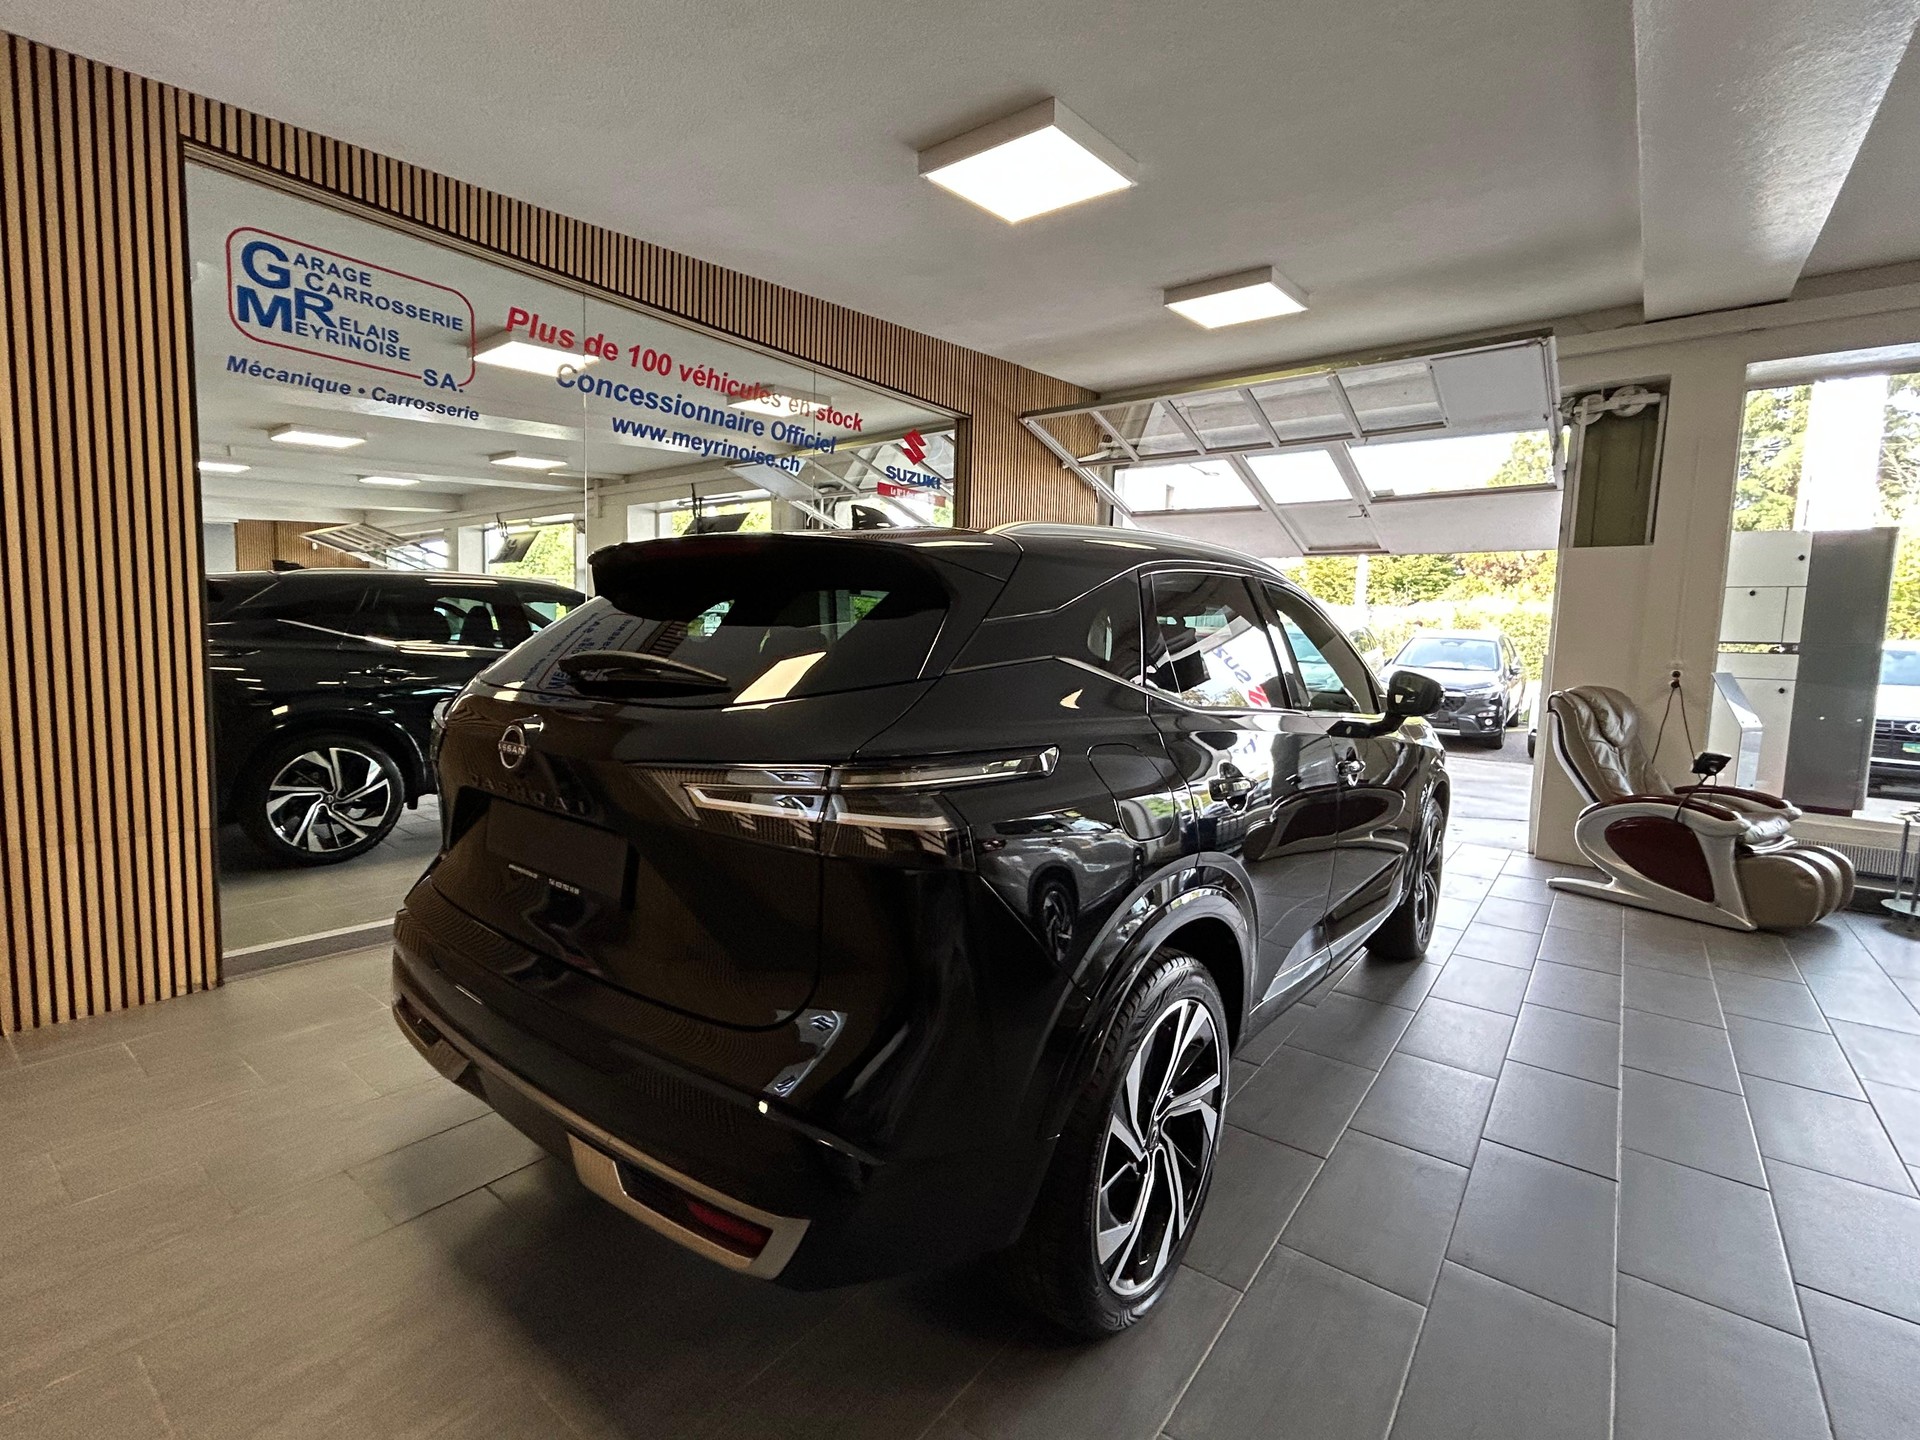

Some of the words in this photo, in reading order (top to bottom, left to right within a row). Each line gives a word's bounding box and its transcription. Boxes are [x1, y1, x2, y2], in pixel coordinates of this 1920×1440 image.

[241, 240, 372, 289] GARAGE
[236, 285, 411, 362] MEYRINOISE
[295, 288, 399, 343] RELAIS
[304, 272, 464, 332] CARROSSERIE
[226, 355, 352, 396] Mécanique
[371, 386, 480, 421] Carrosserie
[423, 368, 464, 393] SA.
[505, 306, 575, 349] Plus
[584, 333, 619, 361] de
[628, 345, 673, 377] 100
[679, 364, 781, 408] véhicules
[788, 398, 811, 417] en
[815, 405, 863, 432] stock
[556, 363, 765, 437] Concessionnaire
[771, 420, 837, 454] Officiel
[612, 416, 801, 473] www.meyrinoise.ch
[885, 465, 941, 490] SUZUKI
[498, 742, 526, 756] SSAN
